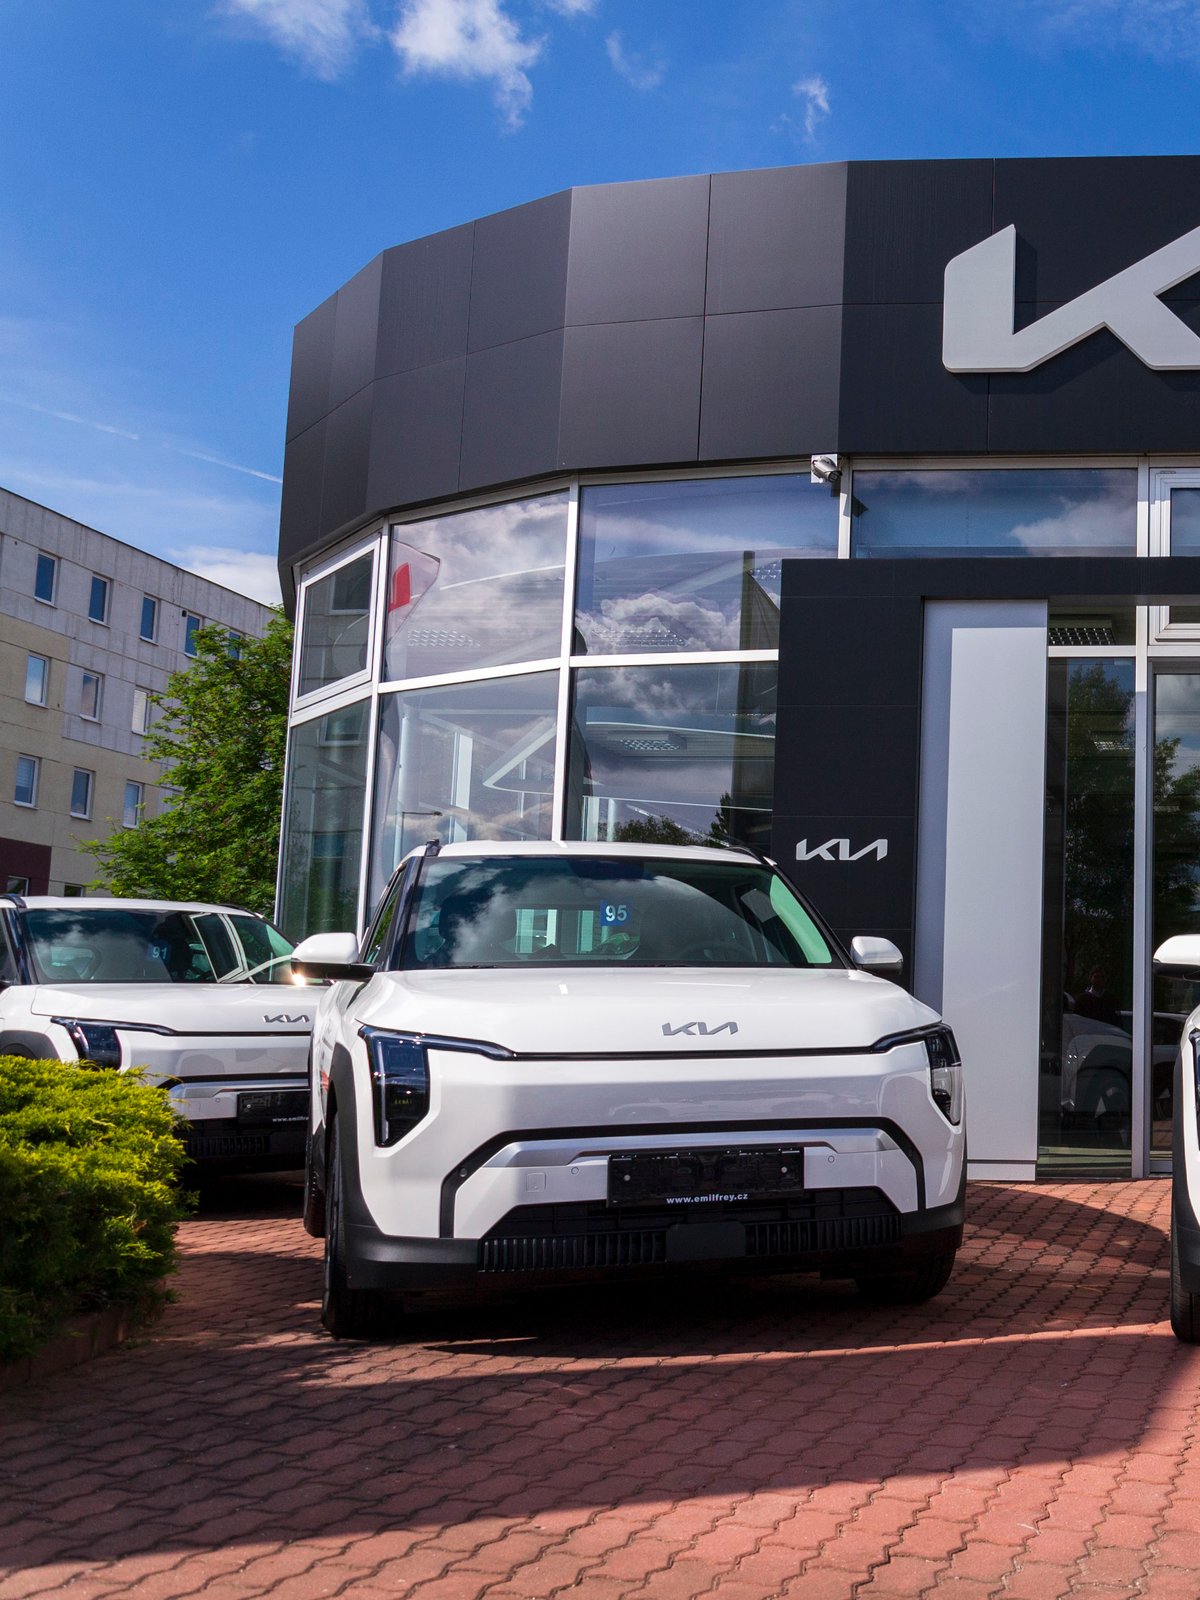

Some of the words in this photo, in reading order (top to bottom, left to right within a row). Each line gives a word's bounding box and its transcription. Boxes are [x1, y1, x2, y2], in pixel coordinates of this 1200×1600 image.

[795, 838, 888, 862] KIA
[605, 904, 628, 922] 95
[661, 1021, 739, 1036] KIA
[666, 1193, 748, 1204] www.emilfrey.cz
